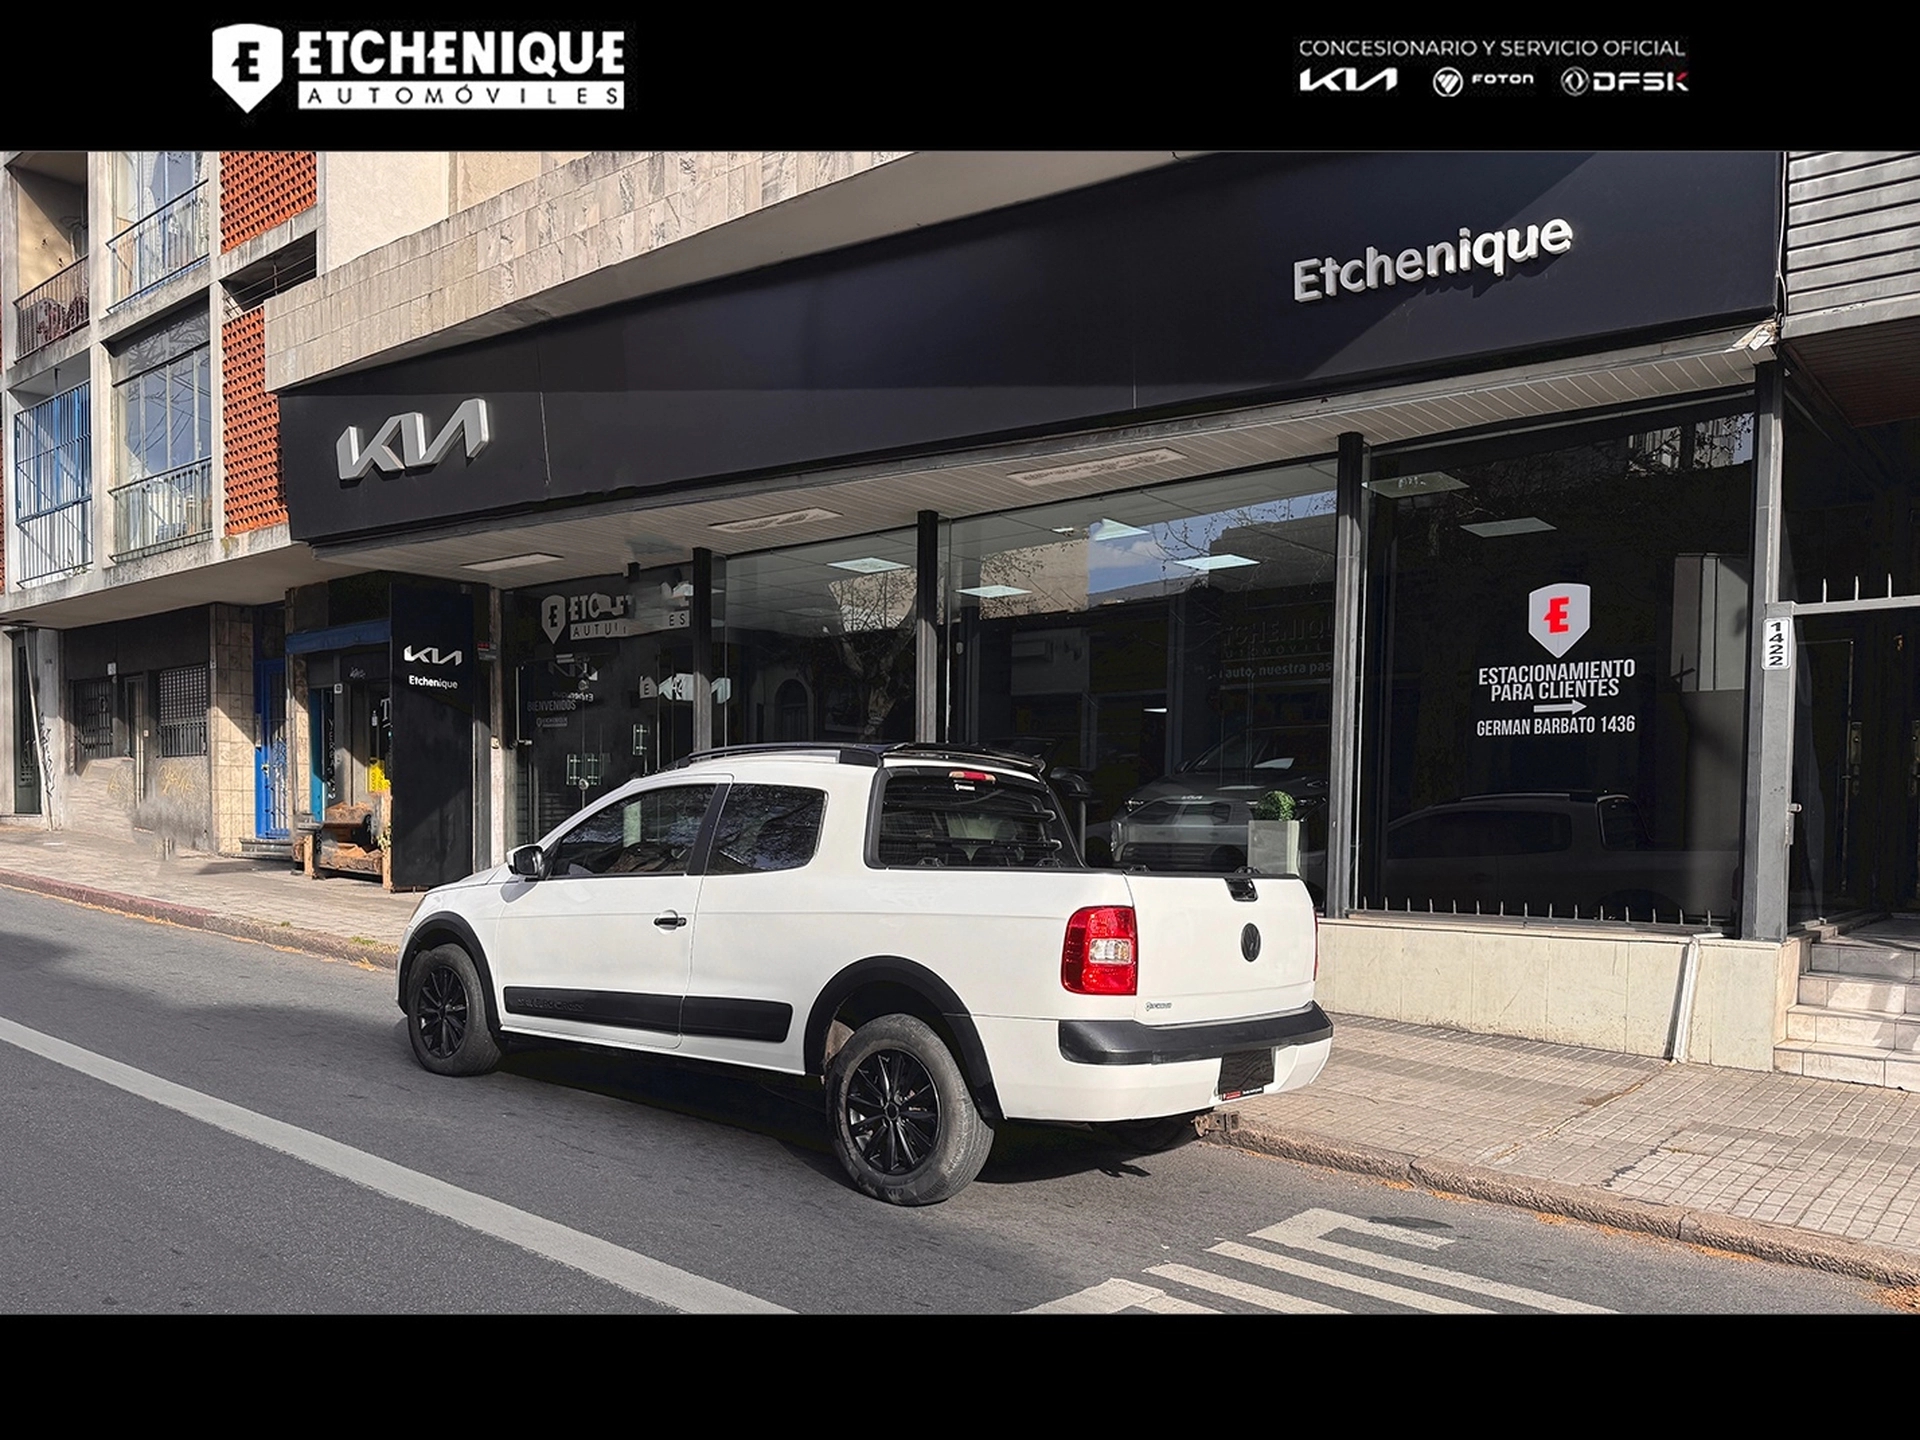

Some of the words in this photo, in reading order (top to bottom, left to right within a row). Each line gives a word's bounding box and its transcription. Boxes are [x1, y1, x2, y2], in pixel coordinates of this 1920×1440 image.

[1294, 217, 1573, 302] Etchenique
[336, 398, 489, 480] KIA
[1769, 621, 1784, 666] 1422
[404, 645, 462, 666] KIA
[1259, 663, 1306, 676] nuestra
[1309, 661, 1332, 675] pas
[1478, 658, 1636, 685] ESTACIONAMIENTO
[409, 675, 458, 690] Etchenique
[1491, 682, 1534, 701] PARA
[1538, 678, 1620, 699] CLIENTES
[1477, 718, 1531, 736] GERMAN
[1534, 716, 1595, 735] BARBATO
[1600, 715, 1636, 733] 1436
